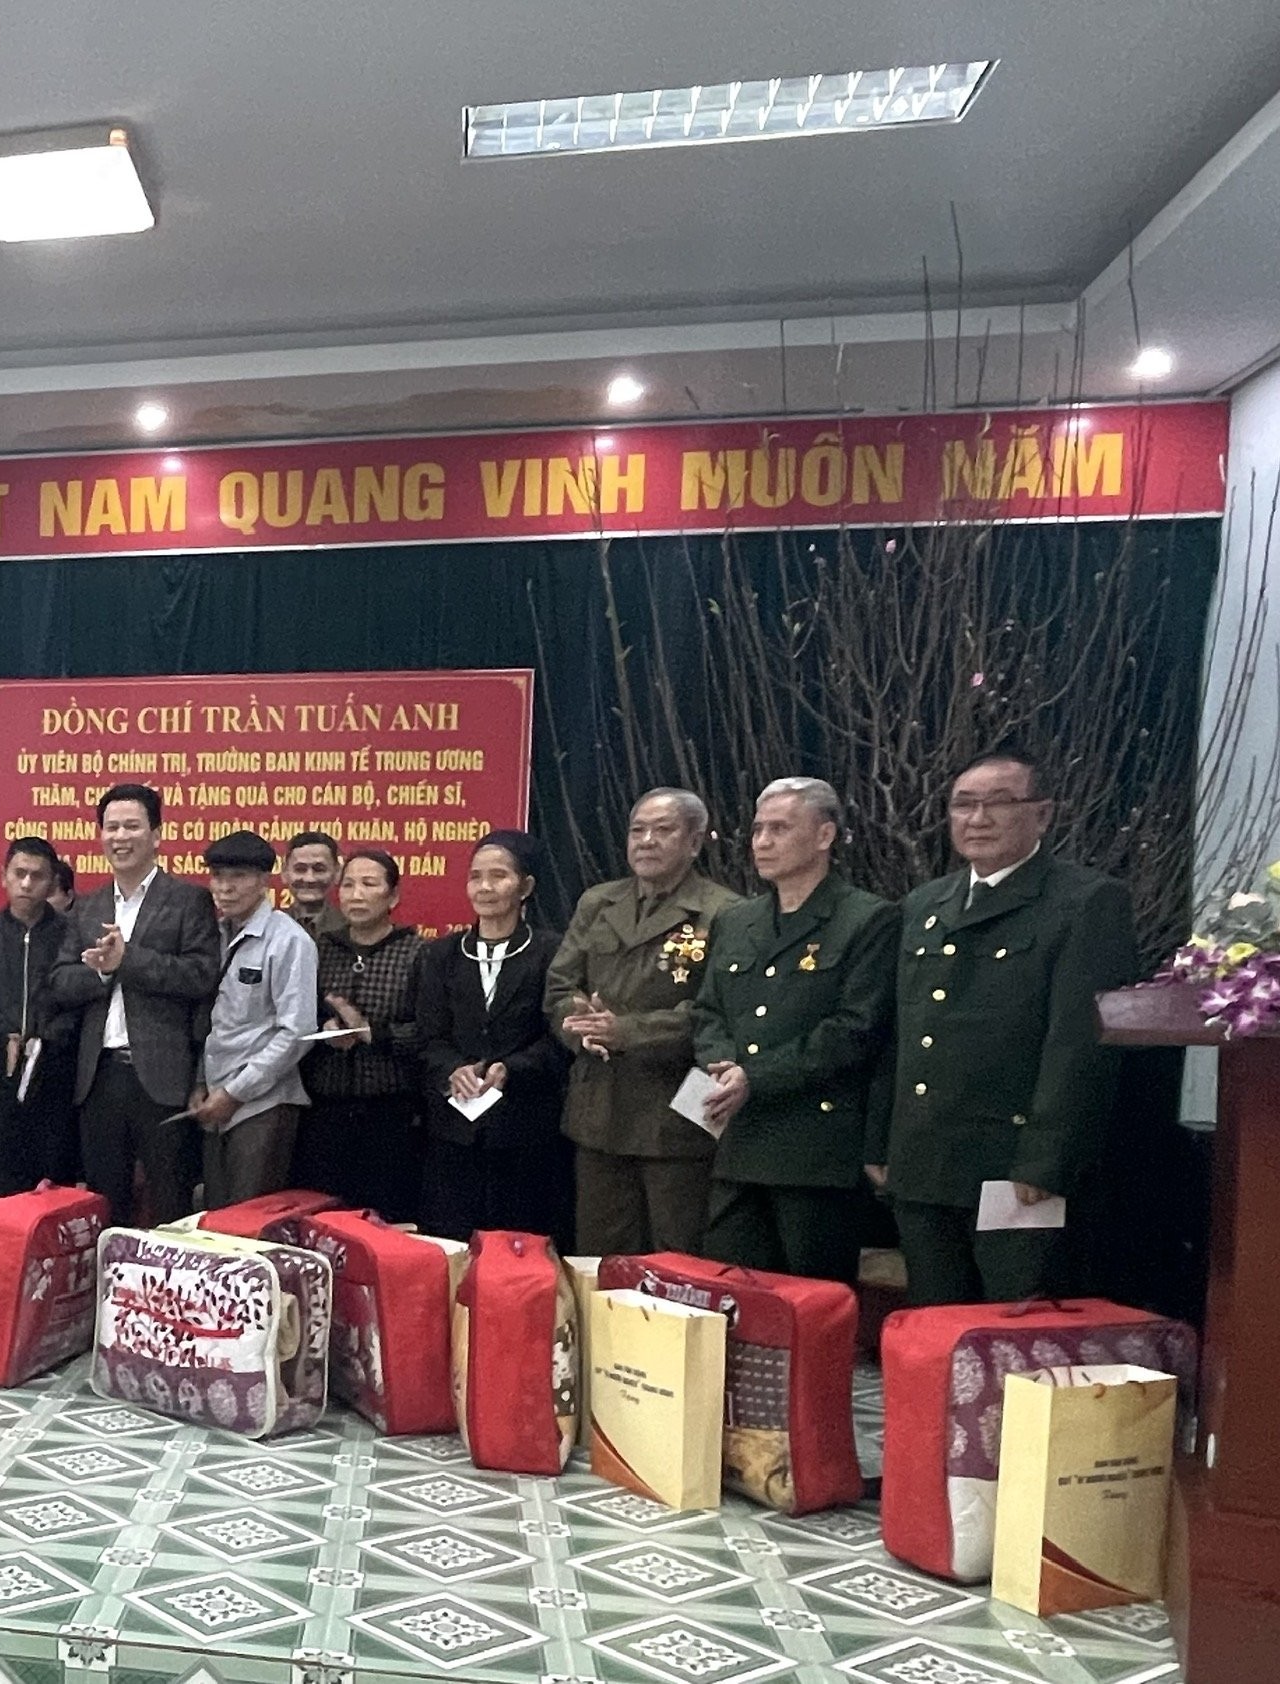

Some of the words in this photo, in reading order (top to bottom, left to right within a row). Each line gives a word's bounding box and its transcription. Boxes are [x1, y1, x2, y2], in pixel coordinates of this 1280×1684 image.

[39, 475, 187, 538] NAM
[219, 462, 446, 535] QUANG
[479, 453, 647, 518] VINH
[679, 432, 905, 511] MUÔN
[942, 424, 1124, 500] NĂM
[41, 696, 129, 735] ĐỒNG
[137, 700, 192, 734] CHÍ
[201, 694, 287, 734] TRẦN
[295, 692, 383, 732] TUẤN
[389, 703, 460, 732] ANH
[42, 750, 78, 774] VIÊN
[81, 749, 104, 778] BỘ
[107, 749, 157, 774] CHÍNH
[161, 753, 191, 777] TRỊ,
[265, 751, 300, 773] BAN
[304, 751, 346, 772] KINH
[351, 744, 372, 772] TẾ
[375, 750, 431, 772] TRUNG
[436, 750, 484, 771] ƯƠNG
[31, 782, 80, 808] THĂM,
[163, 781, 184, 806] VÀ
[188, 782, 231, 810] TẶNG
[235, 781, 269, 808] QUÀ
[273, 785, 308, 806] CHO
[312, 781, 348, 806] CÁN
[352, 780, 381, 811] BỘ,
[387, 779, 439, 806] CHIẾN
[5, 817, 48, 840] CÔNG
[52, 818, 97, 840] NHÂN
[183, 817, 205, 841] CÓ
[347, 818, 399, 843] KHĂN,
[404, 817, 428, 846] HỘ
[432, 817, 491, 841] NGHÈO
